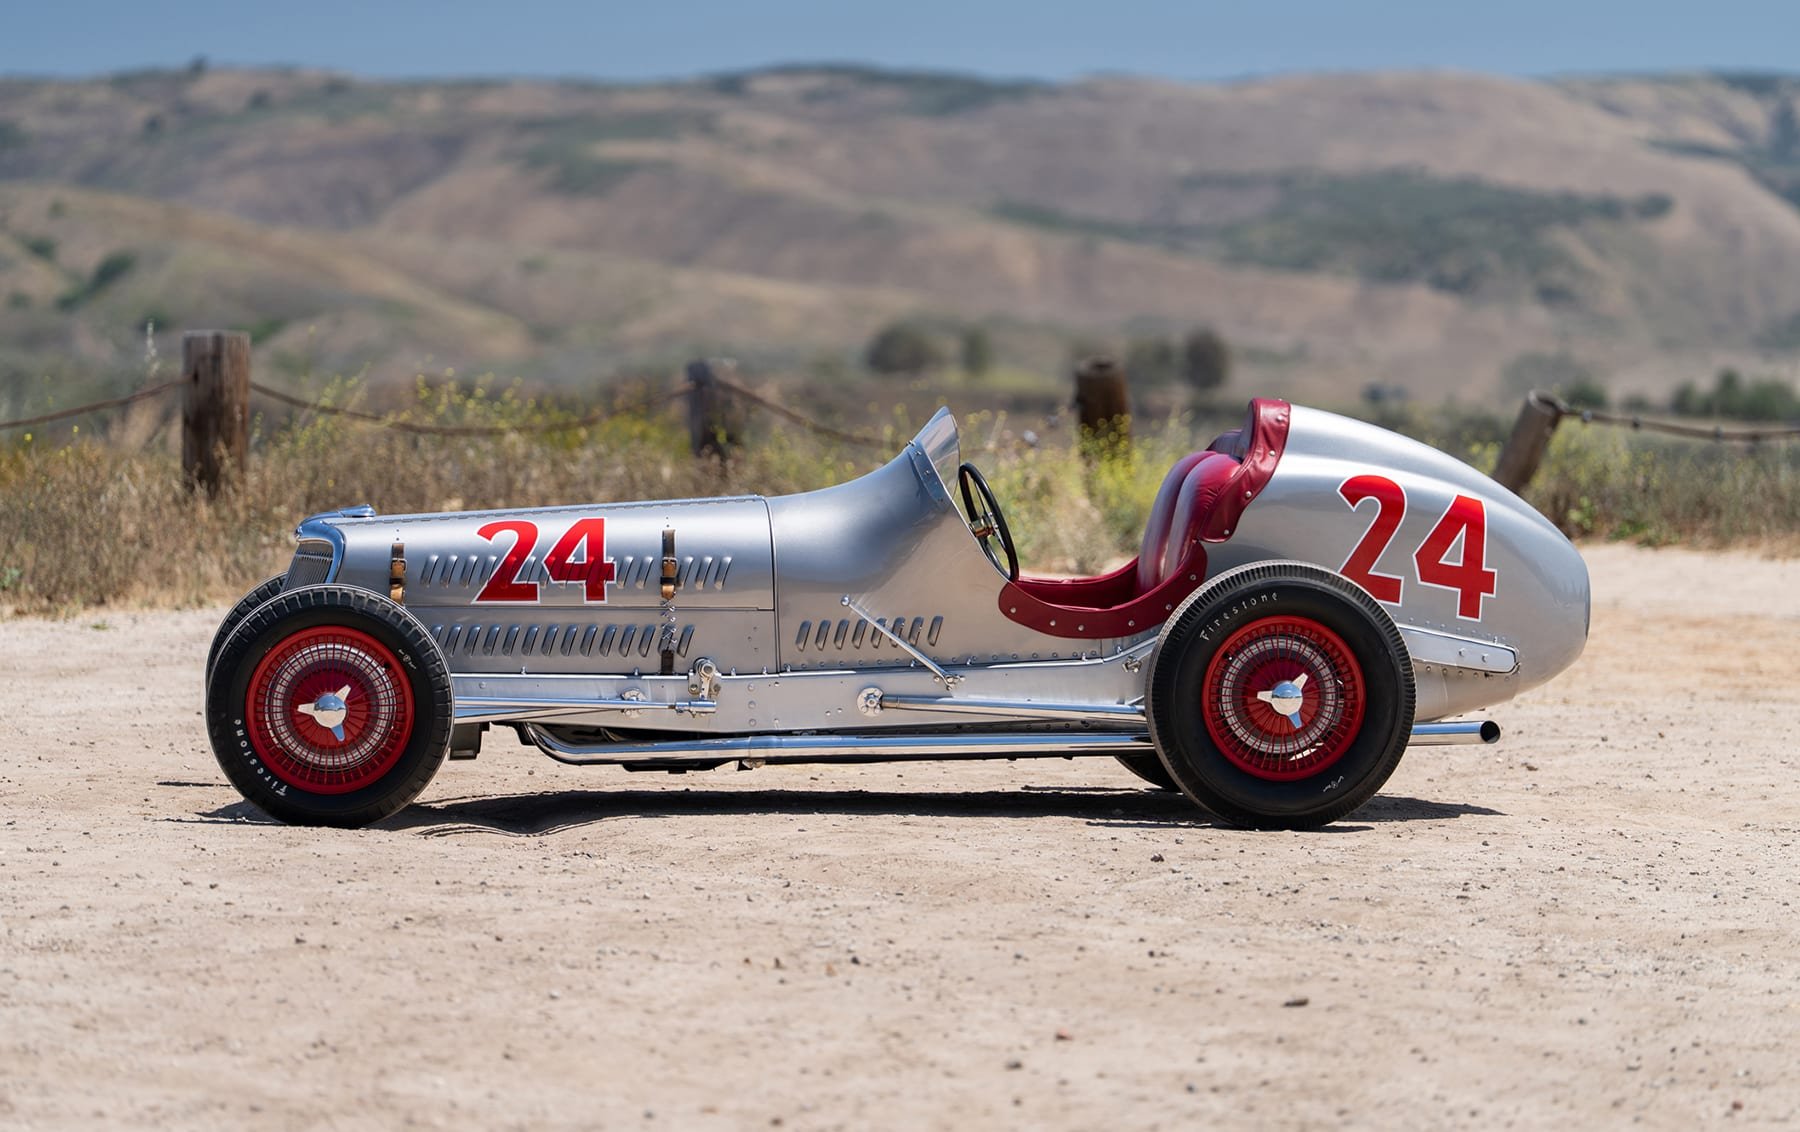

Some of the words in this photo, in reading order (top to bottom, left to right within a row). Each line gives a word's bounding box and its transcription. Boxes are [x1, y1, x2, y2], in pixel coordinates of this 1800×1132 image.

[473, 518, 617, 604] 24
[1337, 475, 1497, 621] 24
[1199, 592, 1278, 641] Firestone
[233, 719, 288, 797] Firestone
